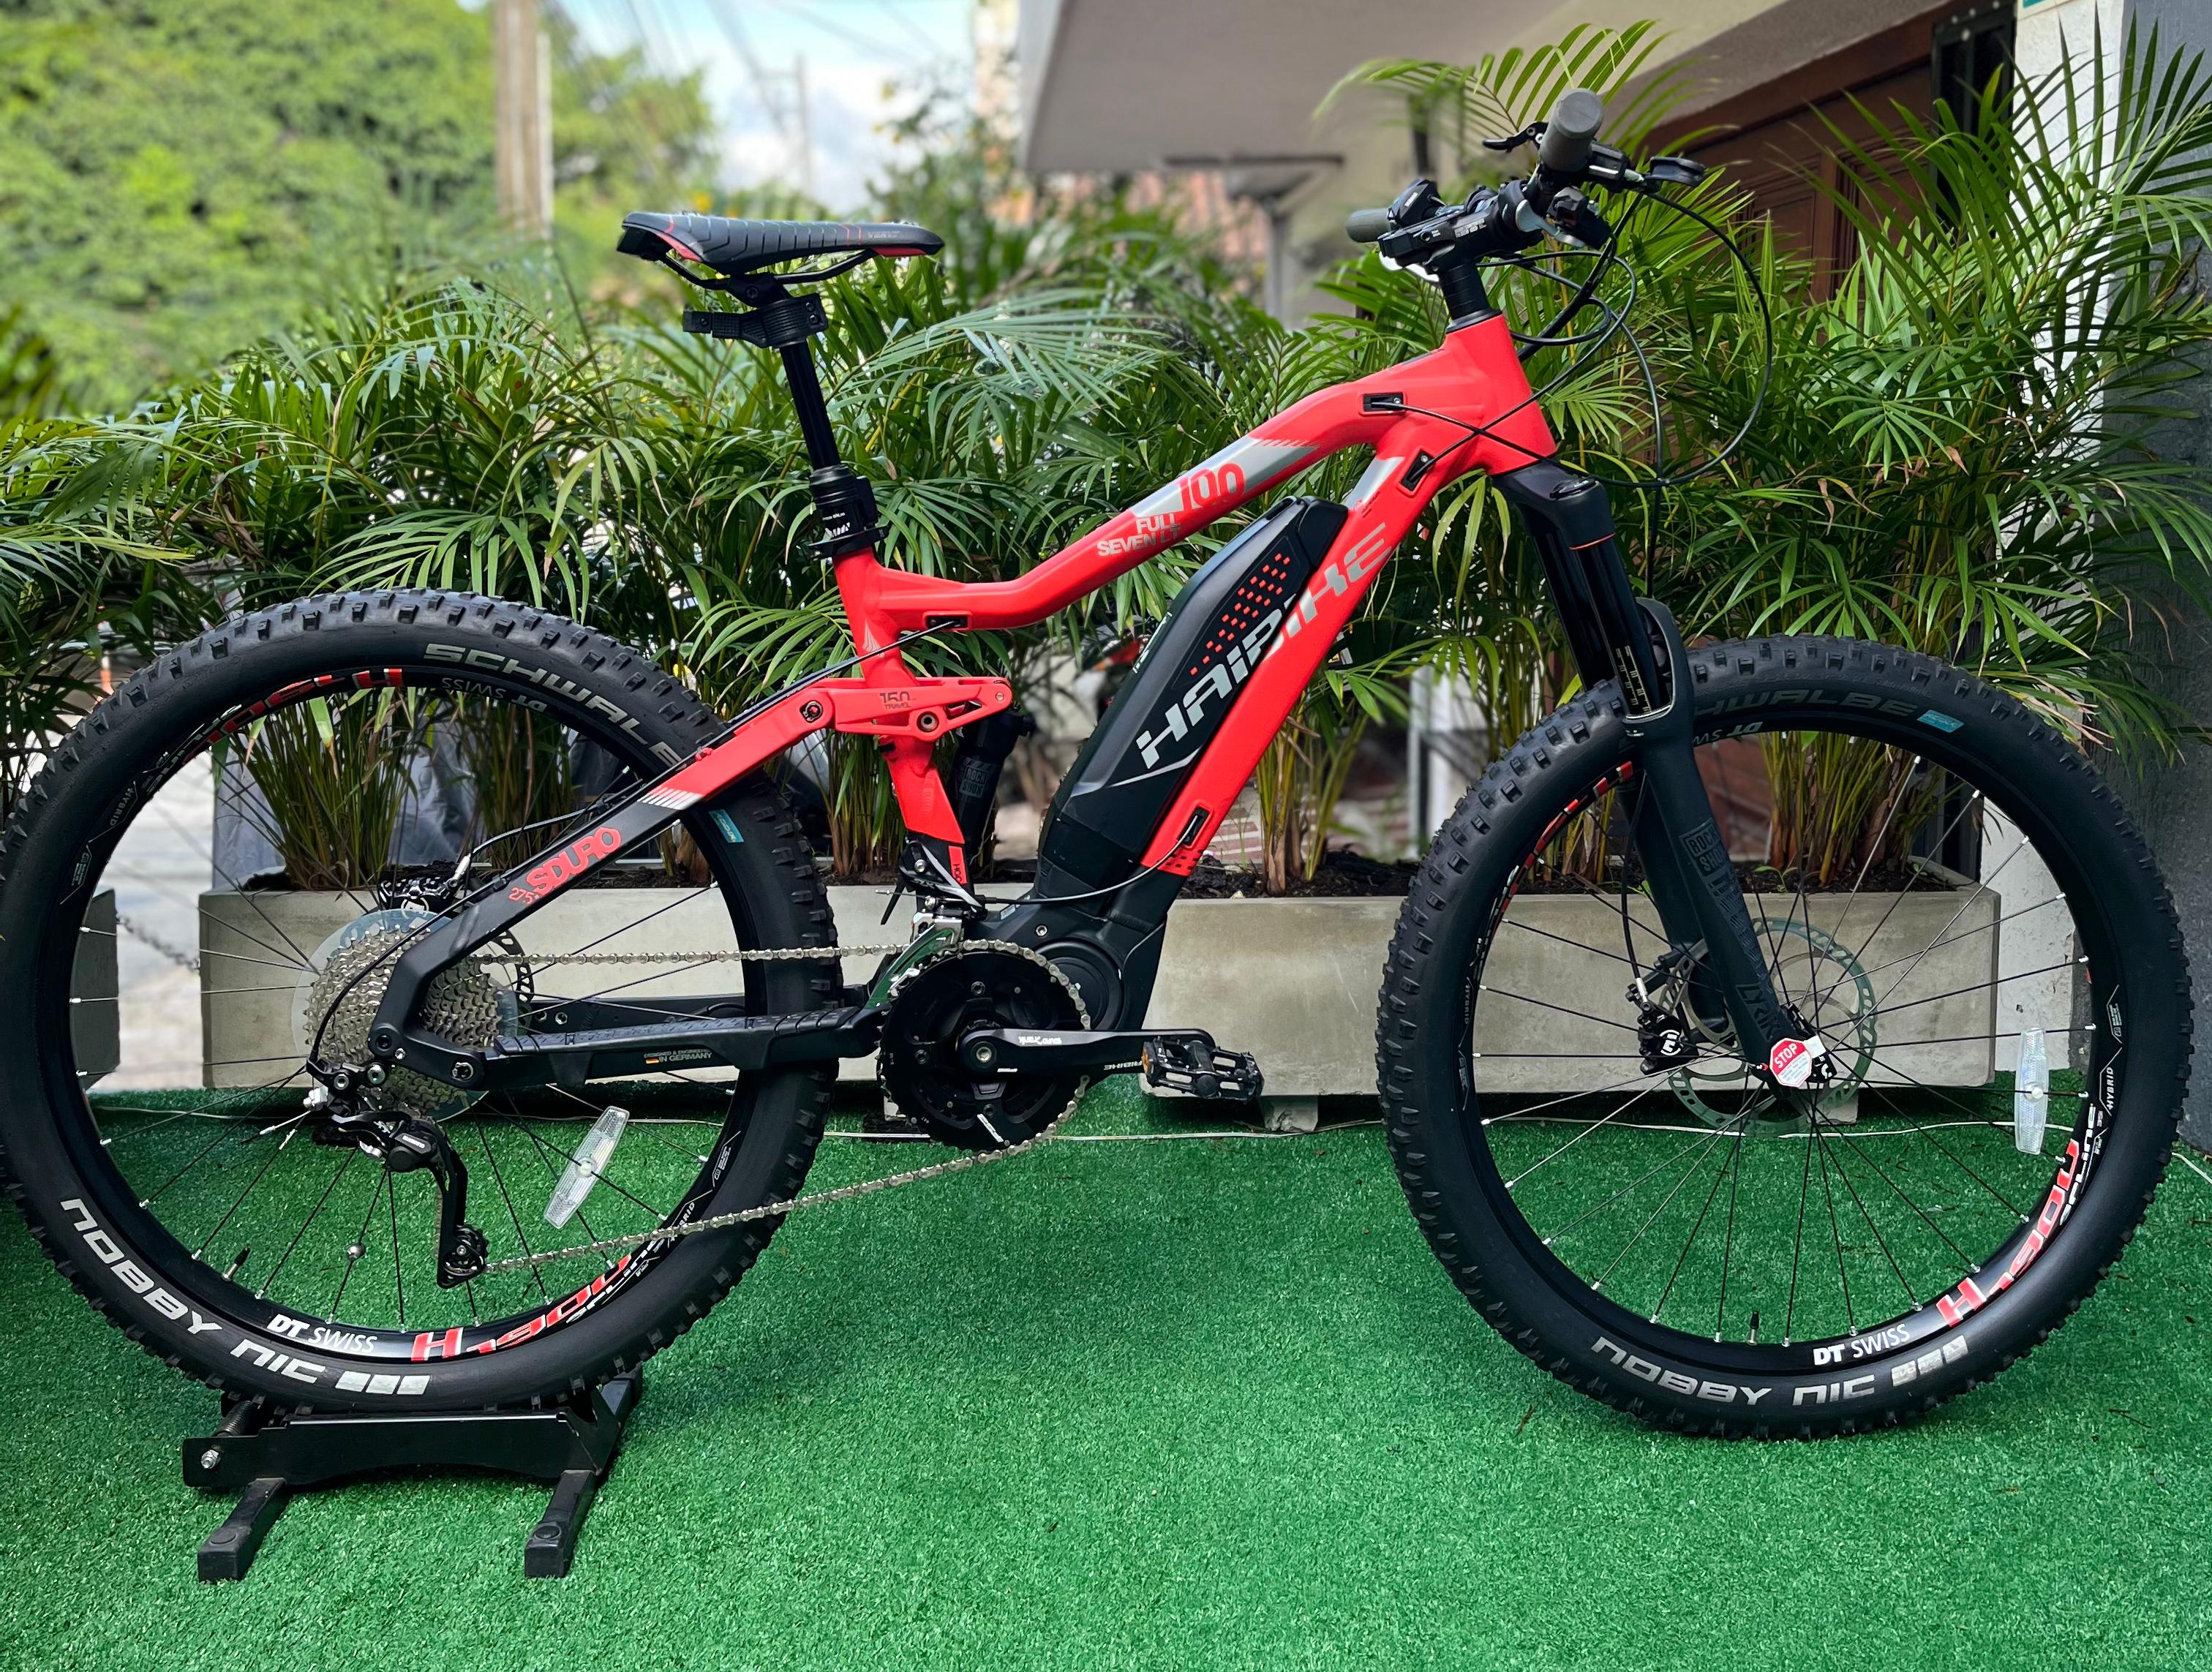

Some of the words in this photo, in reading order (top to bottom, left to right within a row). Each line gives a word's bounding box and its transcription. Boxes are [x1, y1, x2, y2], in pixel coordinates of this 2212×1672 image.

[1136, 513, 1177, 533] FULL
[1097, 532, 1156, 556] SEVEN
[1136, 521, 1391, 769] HAIBIKE
[441, 677, 506, 699] SWISS
[1694, 688, 1919, 717] HWALBE
[423, 643, 682, 769] SCHWALB
[526, 826, 622, 895] SDURO
[669, 1052, 712, 1062] GERMANY
[1774, 1042, 1797, 1069] STOP
[2106, 1066, 2115, 1111] HYBRID
[266, 1314, 311, 1339] DT
[307, 1326, 378, 1353] SWISS
[1813, 1344, 1847, 1366] DT
[1851, 1323, 1911, 1359] SWISS
